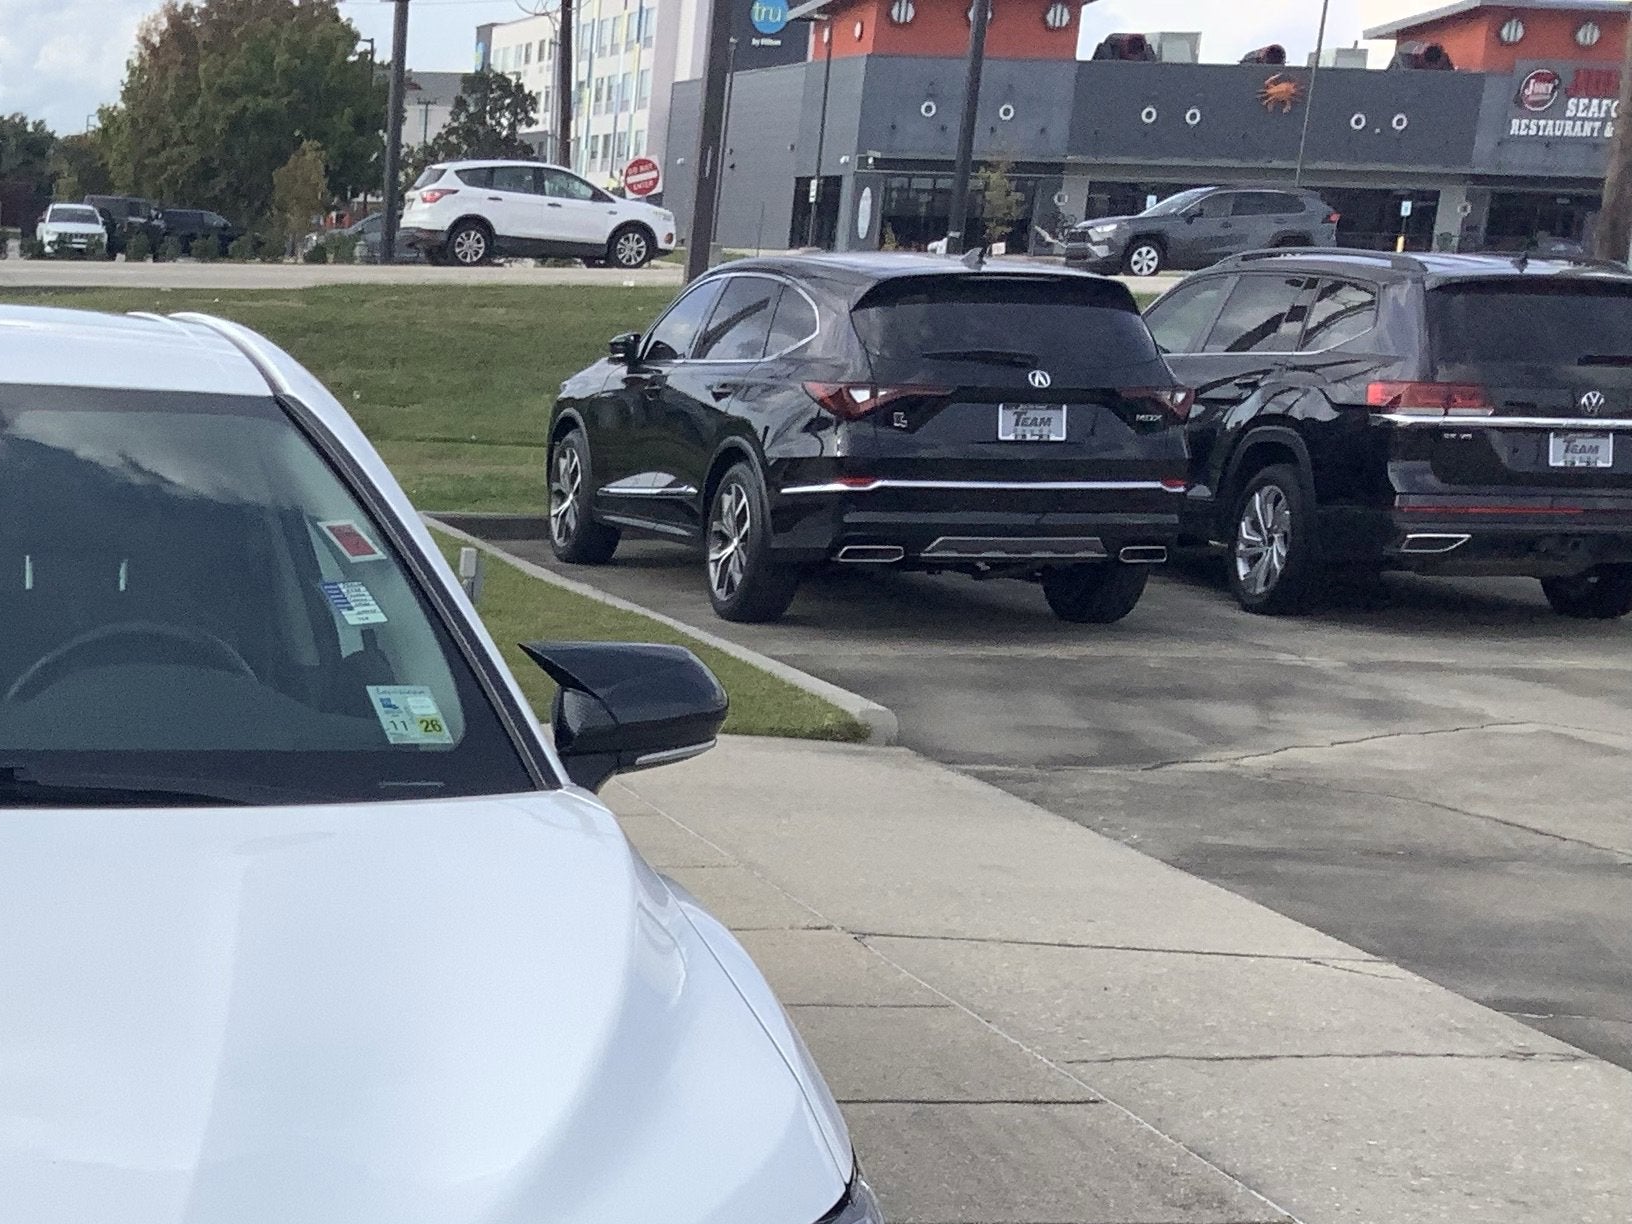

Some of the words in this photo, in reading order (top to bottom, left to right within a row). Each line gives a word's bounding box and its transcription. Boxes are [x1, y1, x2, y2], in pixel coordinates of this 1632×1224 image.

[752, 2, 782, 22] tru
[1509, 118, 1602, 137] RESTAURANT
[1603, 121, 1615, 138] &
[1013, 411, 1053, 427] TEAM
[419, 719, 443, 733] 26
